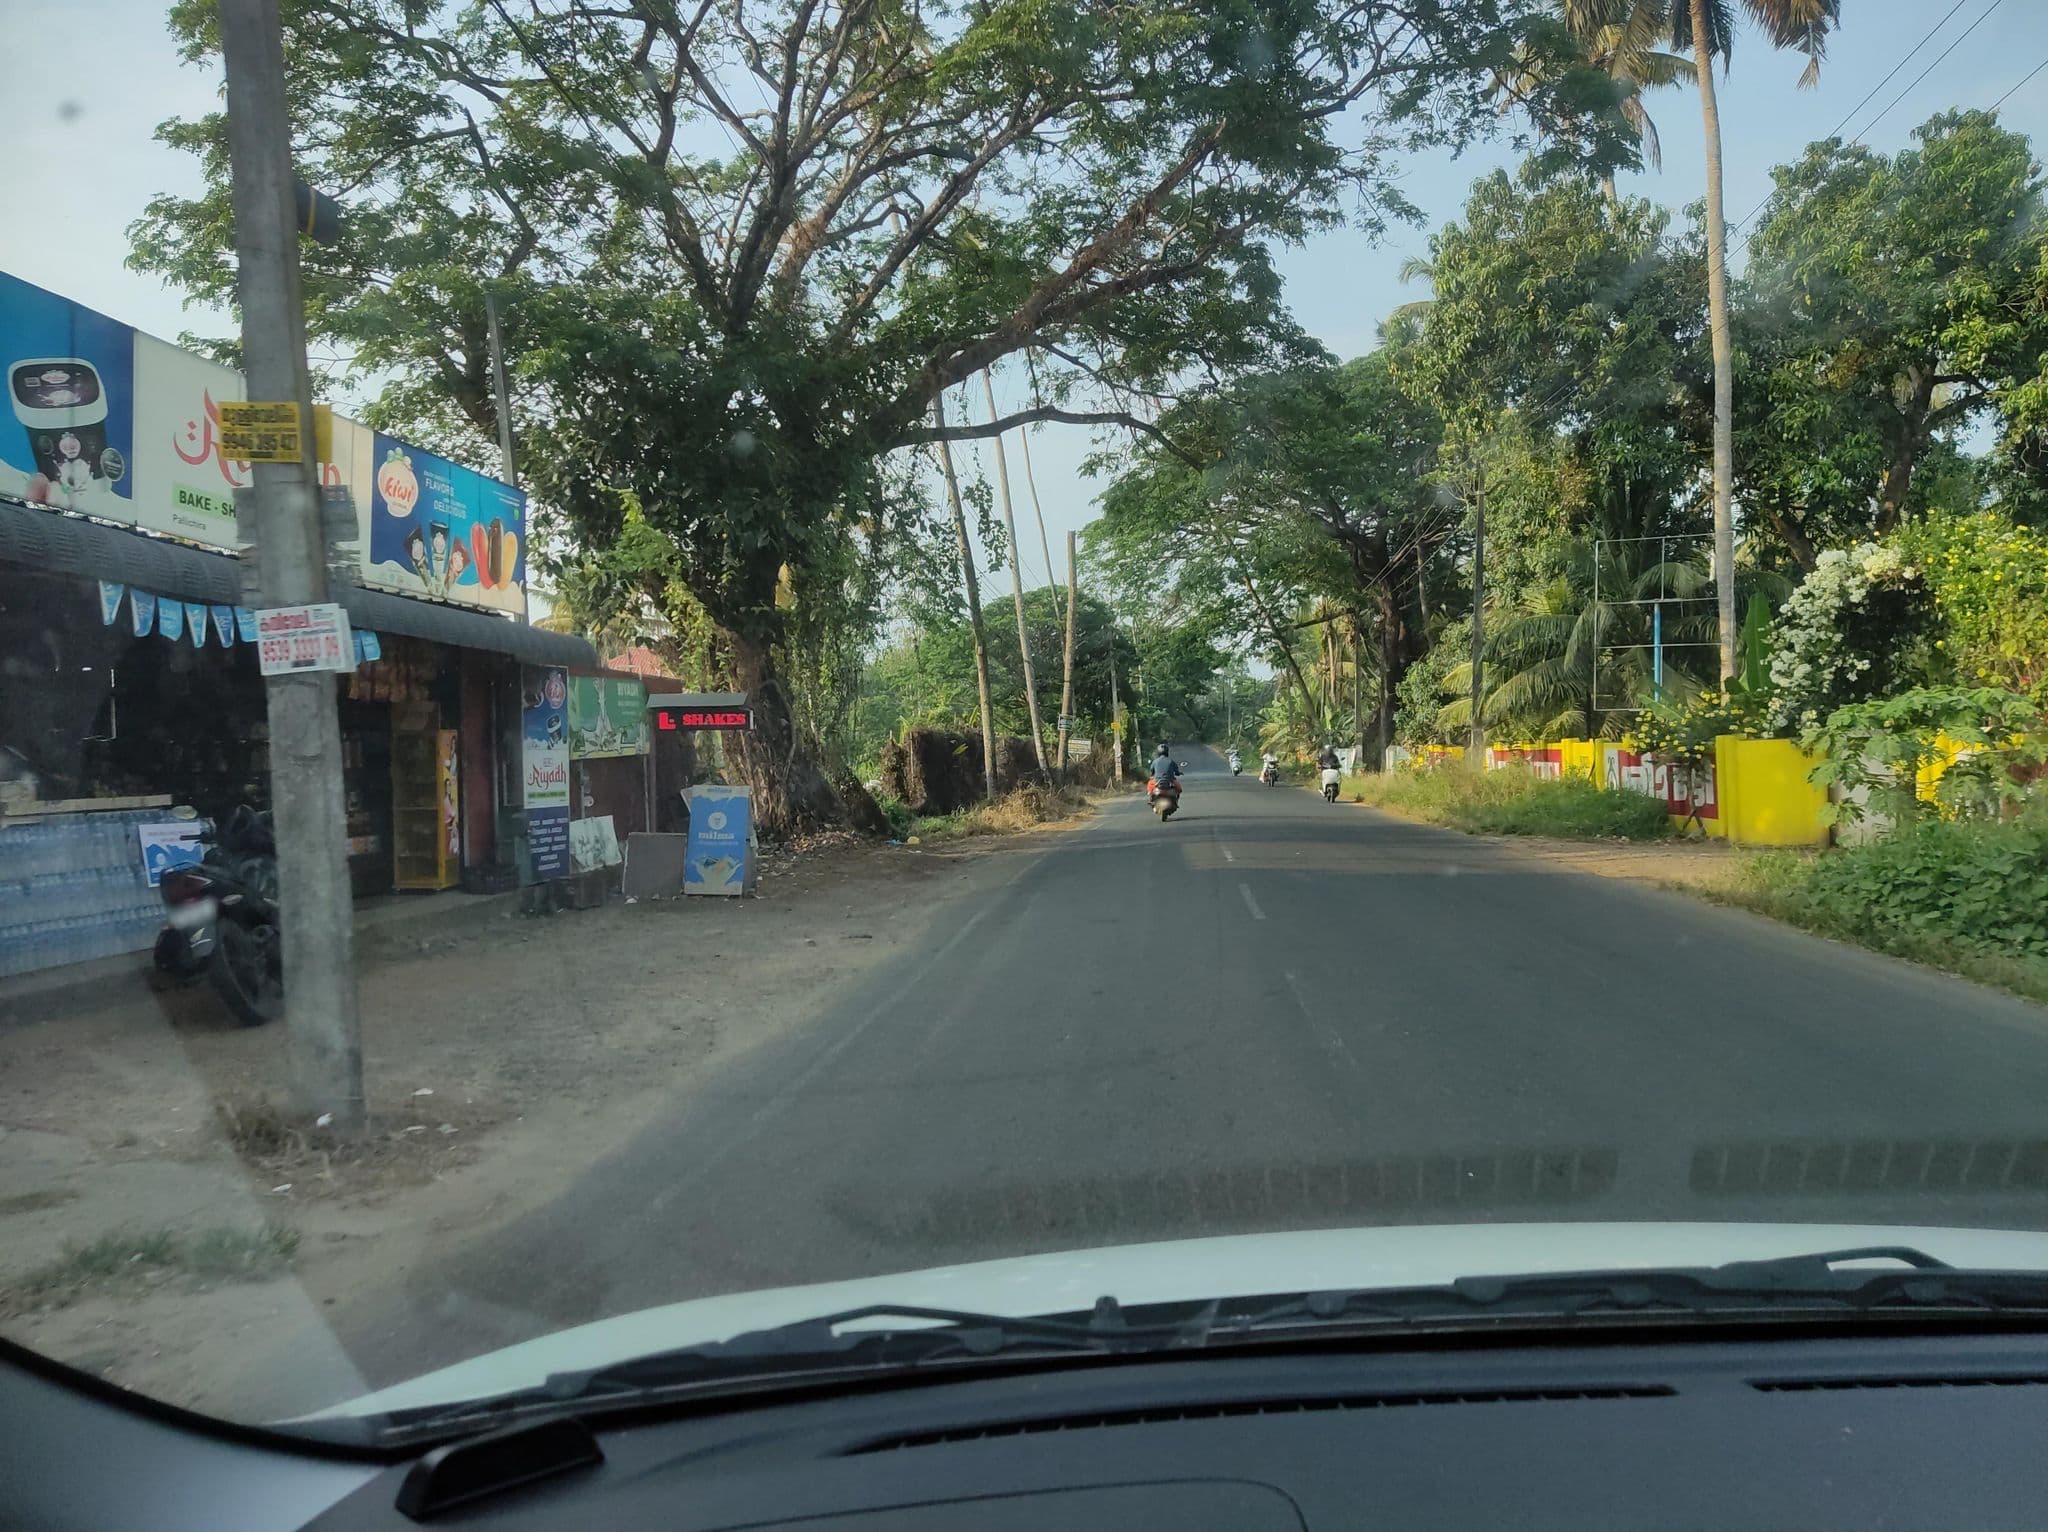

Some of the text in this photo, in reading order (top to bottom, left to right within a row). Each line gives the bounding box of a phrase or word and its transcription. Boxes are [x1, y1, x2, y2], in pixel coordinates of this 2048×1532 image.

[179, 489, 212, 511] BAKE
[384, 476, 414, 503] kiwi
[682, 713, 746, 725] SHAKES
[527, 761, 567, 790] Riyadh
